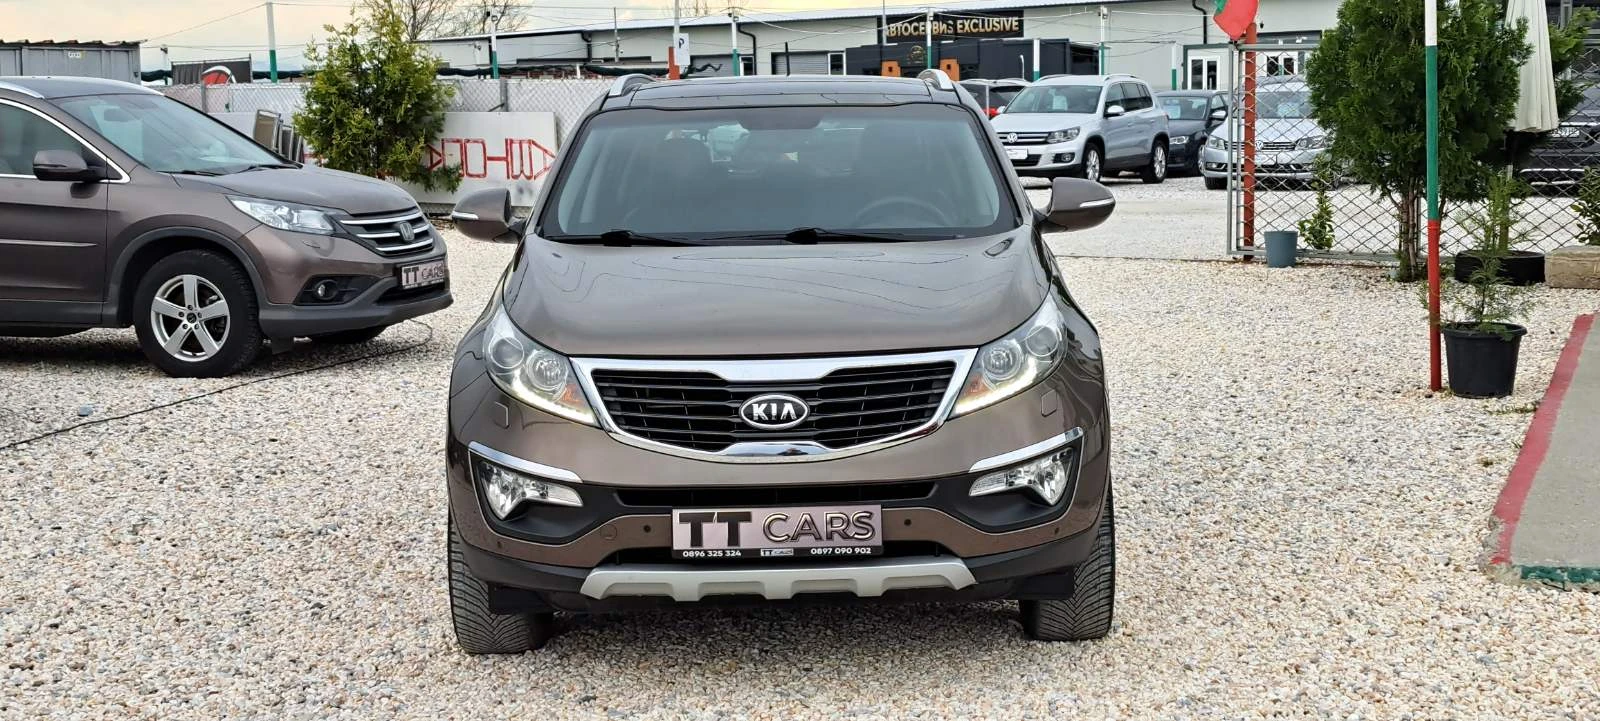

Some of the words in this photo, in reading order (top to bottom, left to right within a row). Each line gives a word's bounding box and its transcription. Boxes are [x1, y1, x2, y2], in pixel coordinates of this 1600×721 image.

[957, 16, 1019, 32] EXCLUSIVE
[403, 266, 420, 284] TT
[422, 262, 444, 280] CARS
[752, 402, 797, 421] KIA
[679, 511, 752, 548] TT
[762, 511, 876, 543] CARS
[682, 550, 705, 558] 0896
[725, 549, 742, 557] 324
[810, 547, 833, 555] 0897
[834, 547, 852, 555] 090
